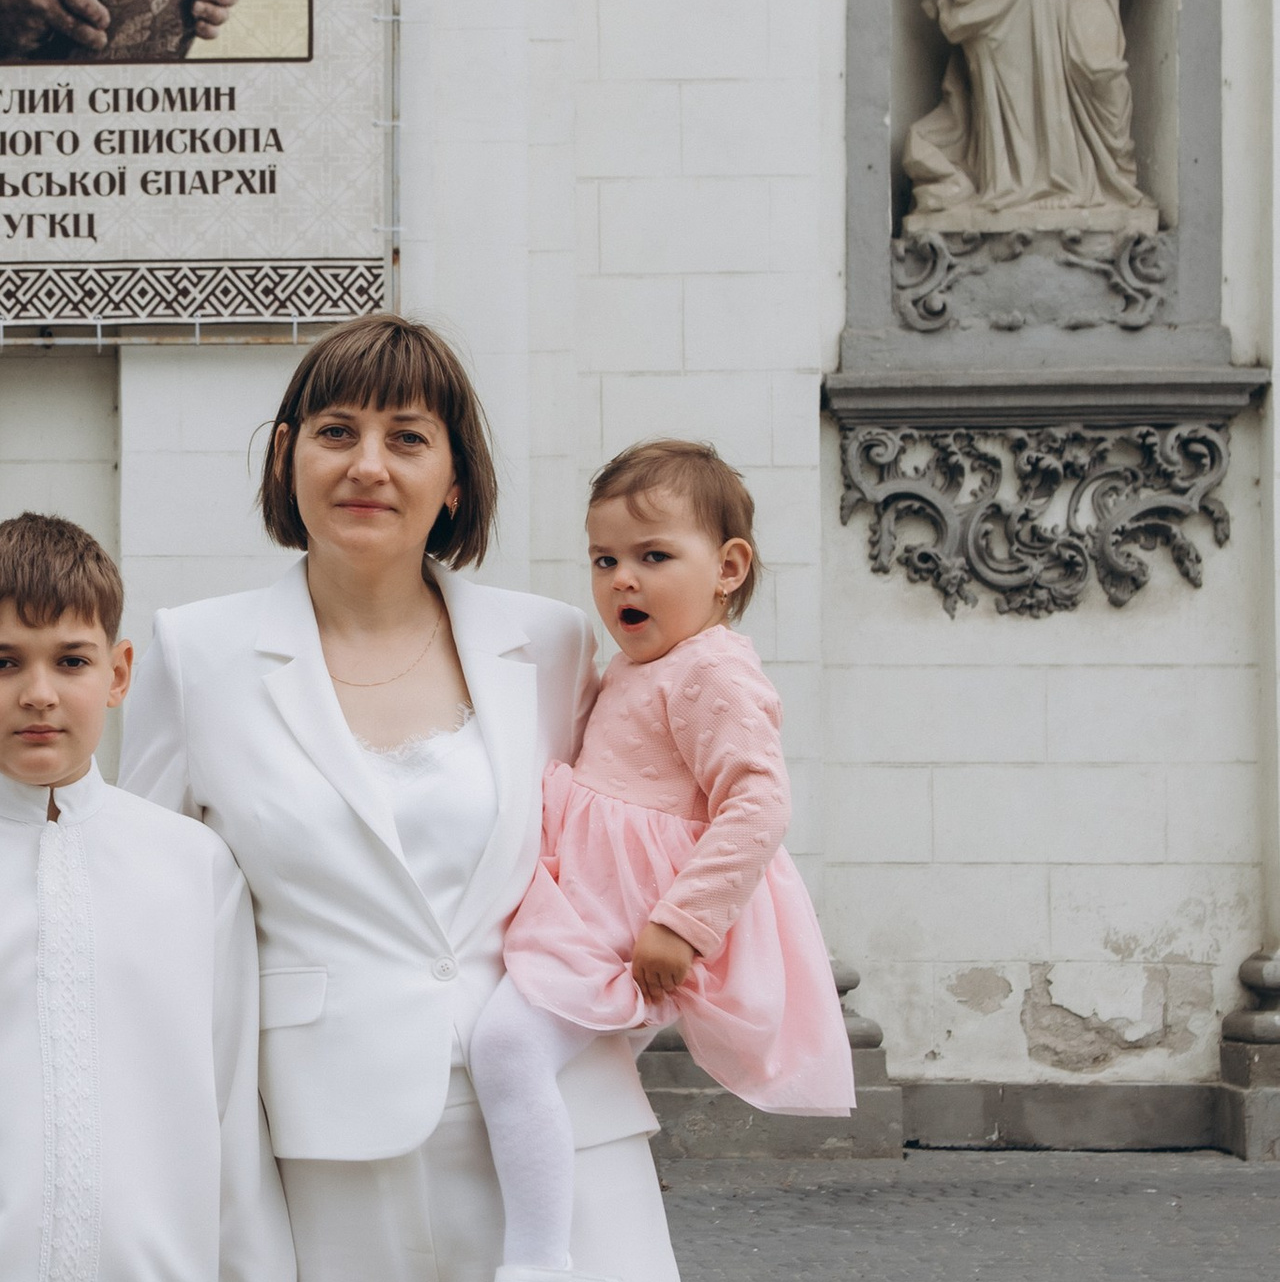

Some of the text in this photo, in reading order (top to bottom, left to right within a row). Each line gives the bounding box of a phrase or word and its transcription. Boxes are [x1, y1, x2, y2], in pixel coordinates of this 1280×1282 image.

[87, 85, 237, 115] СПОМИН
[93, 127, 285, 156] ЄПИСКОПА
[139, 163, 277, 197] ЄПАРХІЇ
[2, 212, 98, 244] УГКЦ
